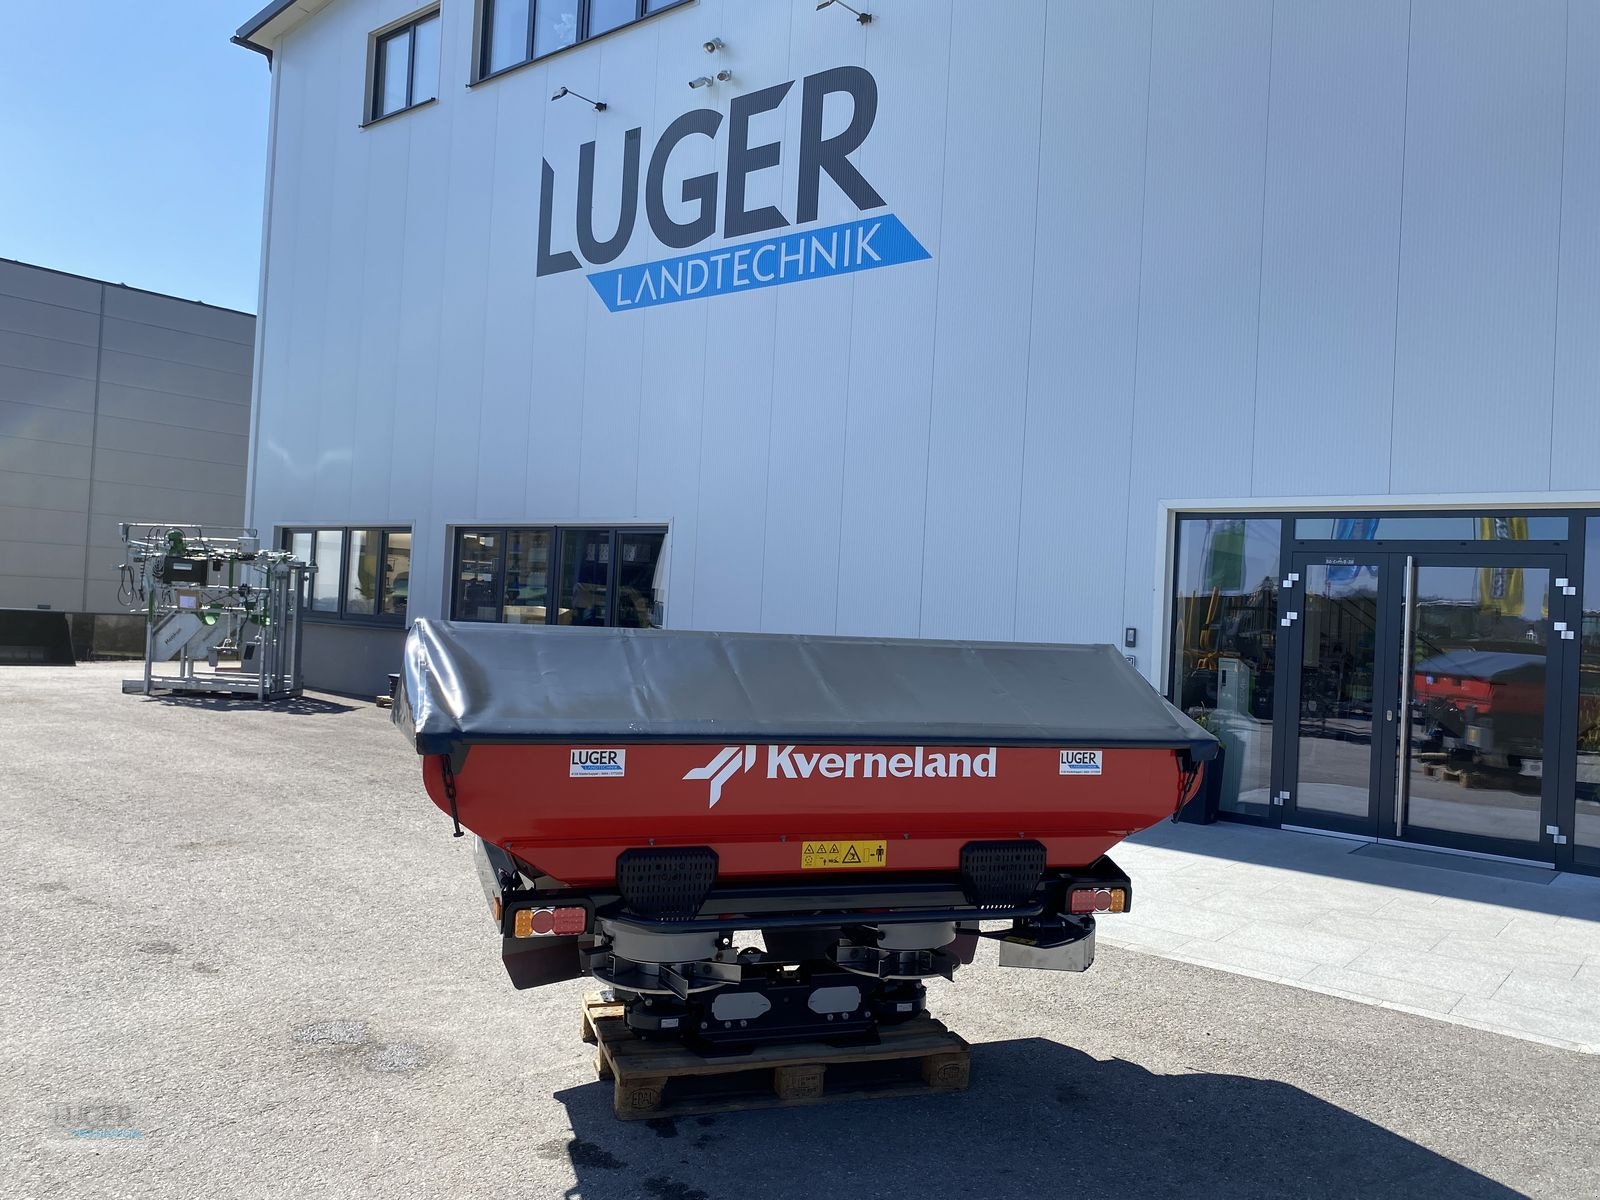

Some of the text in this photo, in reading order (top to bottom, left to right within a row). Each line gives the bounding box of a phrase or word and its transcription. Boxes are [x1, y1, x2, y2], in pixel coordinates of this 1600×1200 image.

[537, 66, 888, 277] LUGER
[616, 222, 882, 307] LANDTECHNIK
[572, 751, 618, 765] LUGER
[767, 745, 997, 778] Kverneland
[1061, 752, 1097, 764] LUGER
